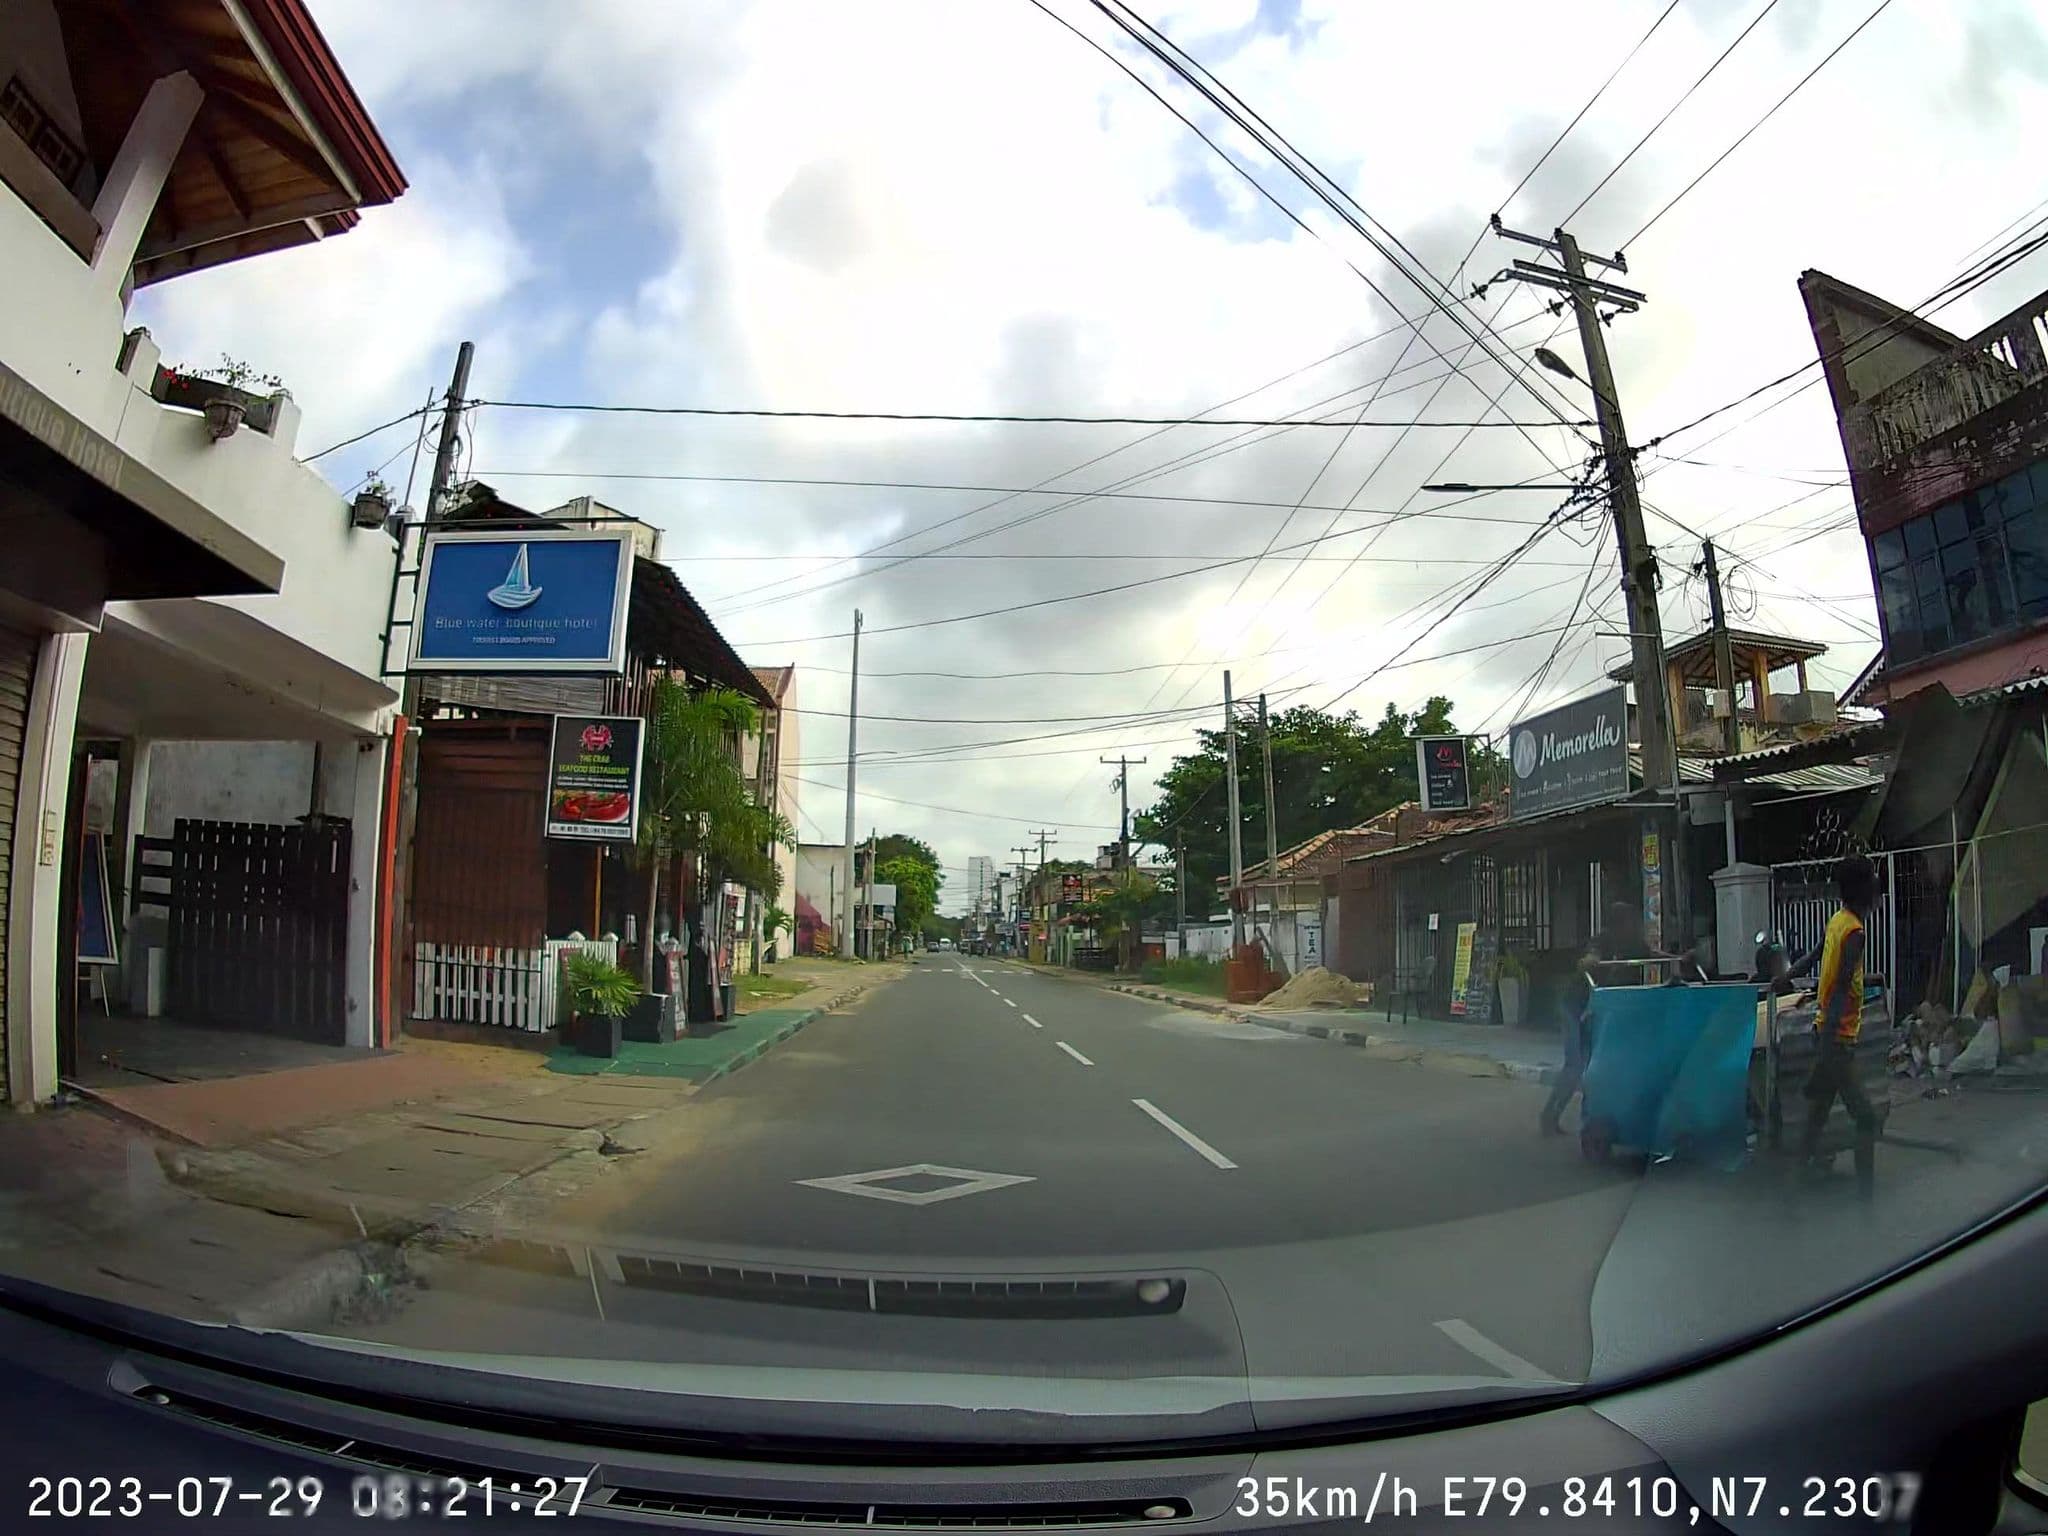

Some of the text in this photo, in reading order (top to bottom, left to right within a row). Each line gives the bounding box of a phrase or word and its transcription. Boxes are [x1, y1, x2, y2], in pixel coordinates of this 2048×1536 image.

[435, 616, 598, 631] Blue water boutique hotel
[1539, 714, 1621, 767] Memorella
